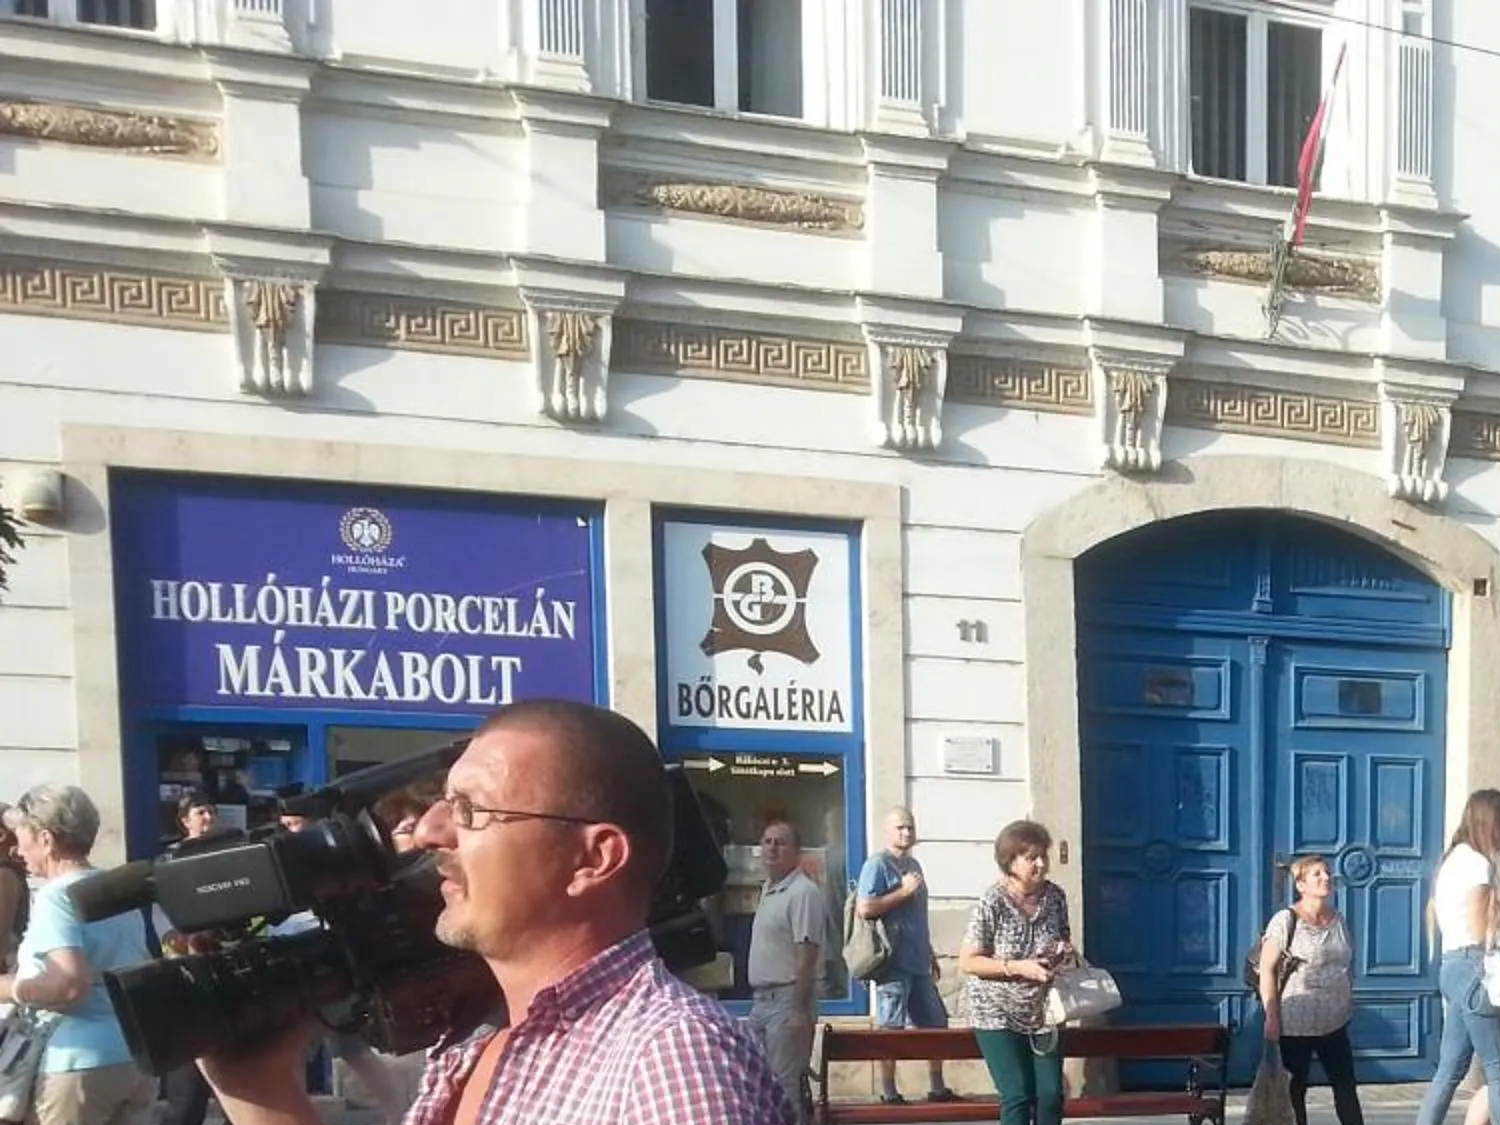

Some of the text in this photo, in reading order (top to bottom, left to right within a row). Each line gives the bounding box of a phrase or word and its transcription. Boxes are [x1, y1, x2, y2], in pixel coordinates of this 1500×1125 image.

[150, 572, 577, 640] HOLLÓHÁZI PORCELÁN
[214, 629, 522, 706] MÁRKABOLT
[677, 675, 845, 723] BŐRGALÉRIA
